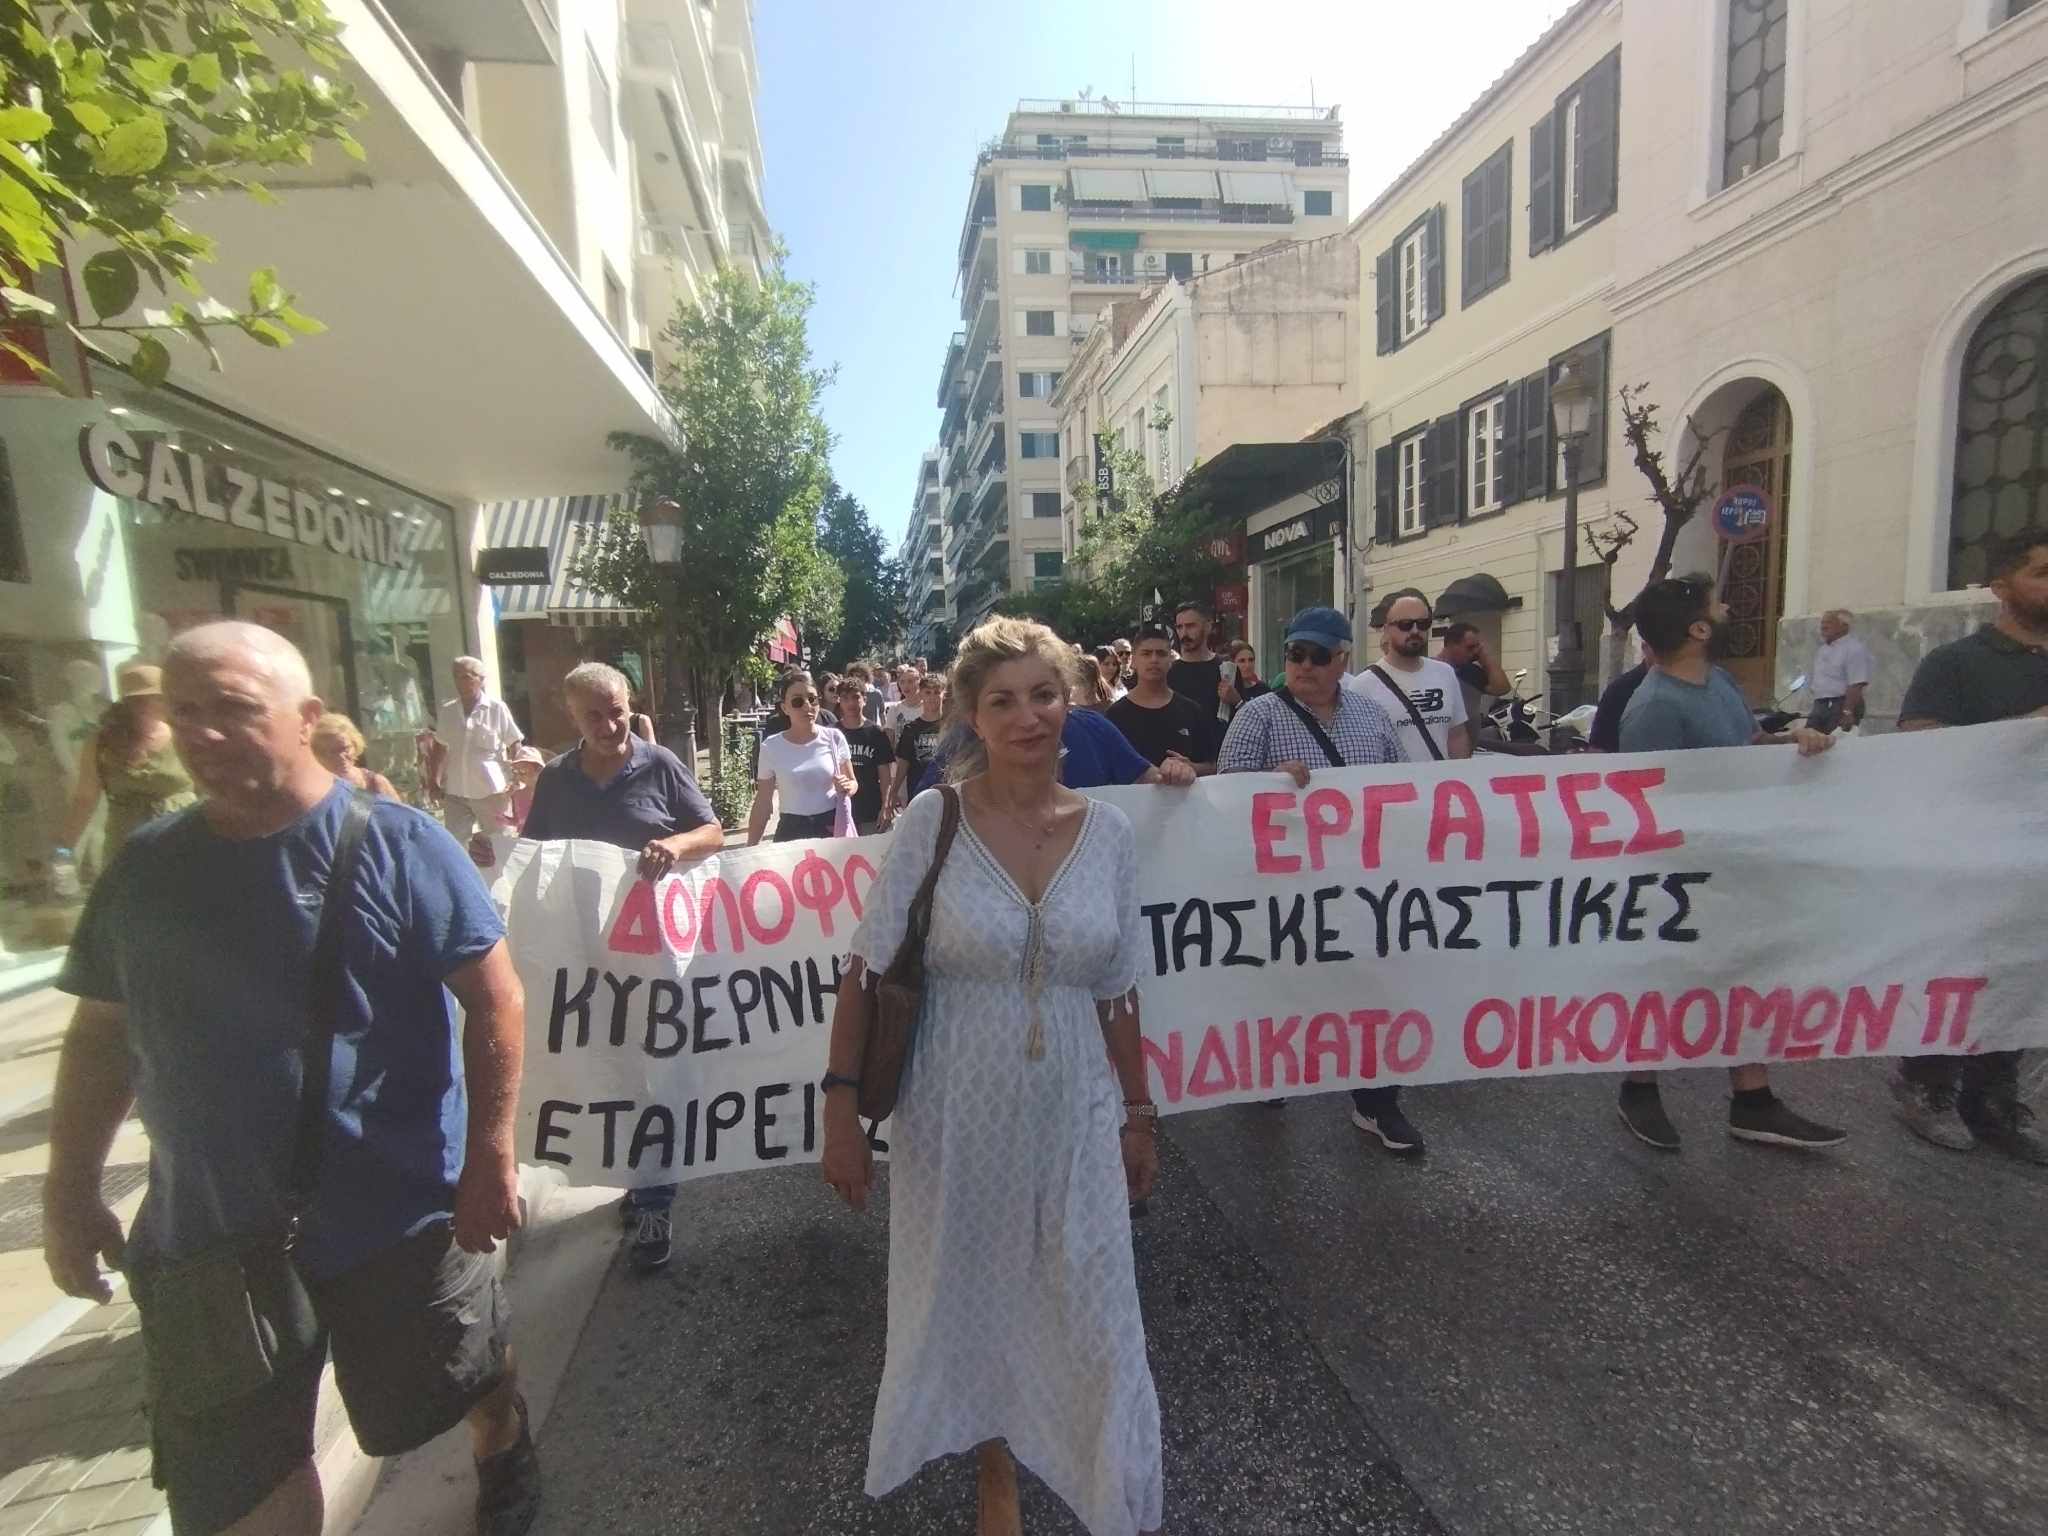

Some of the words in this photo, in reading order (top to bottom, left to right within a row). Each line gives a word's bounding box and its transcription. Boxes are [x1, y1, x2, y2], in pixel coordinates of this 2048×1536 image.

[78, 422, 409, 571] CALZEDONIA
[1099, 467, 1109, 489] BSB
[488, 571, 545, 580] CALZEDONIA
[1264, 520, 1309, 550] NOVA
[1251, 768, 1684, 874] ΕΡΓΑΤΕΣ
[1141, 872, 1712, 975] ΤΑΣΚΕΥΑΣΤΙΚΕΣ
[547, 954, 842, 1058] ΚΥΒΕΡΝΗ
[1463, 985, 1903, 1070] ΟΙΚΟΔΟΜΩΝ
[534, 1083, 889, 1168] ΕΤΑΙΡΕΙ
